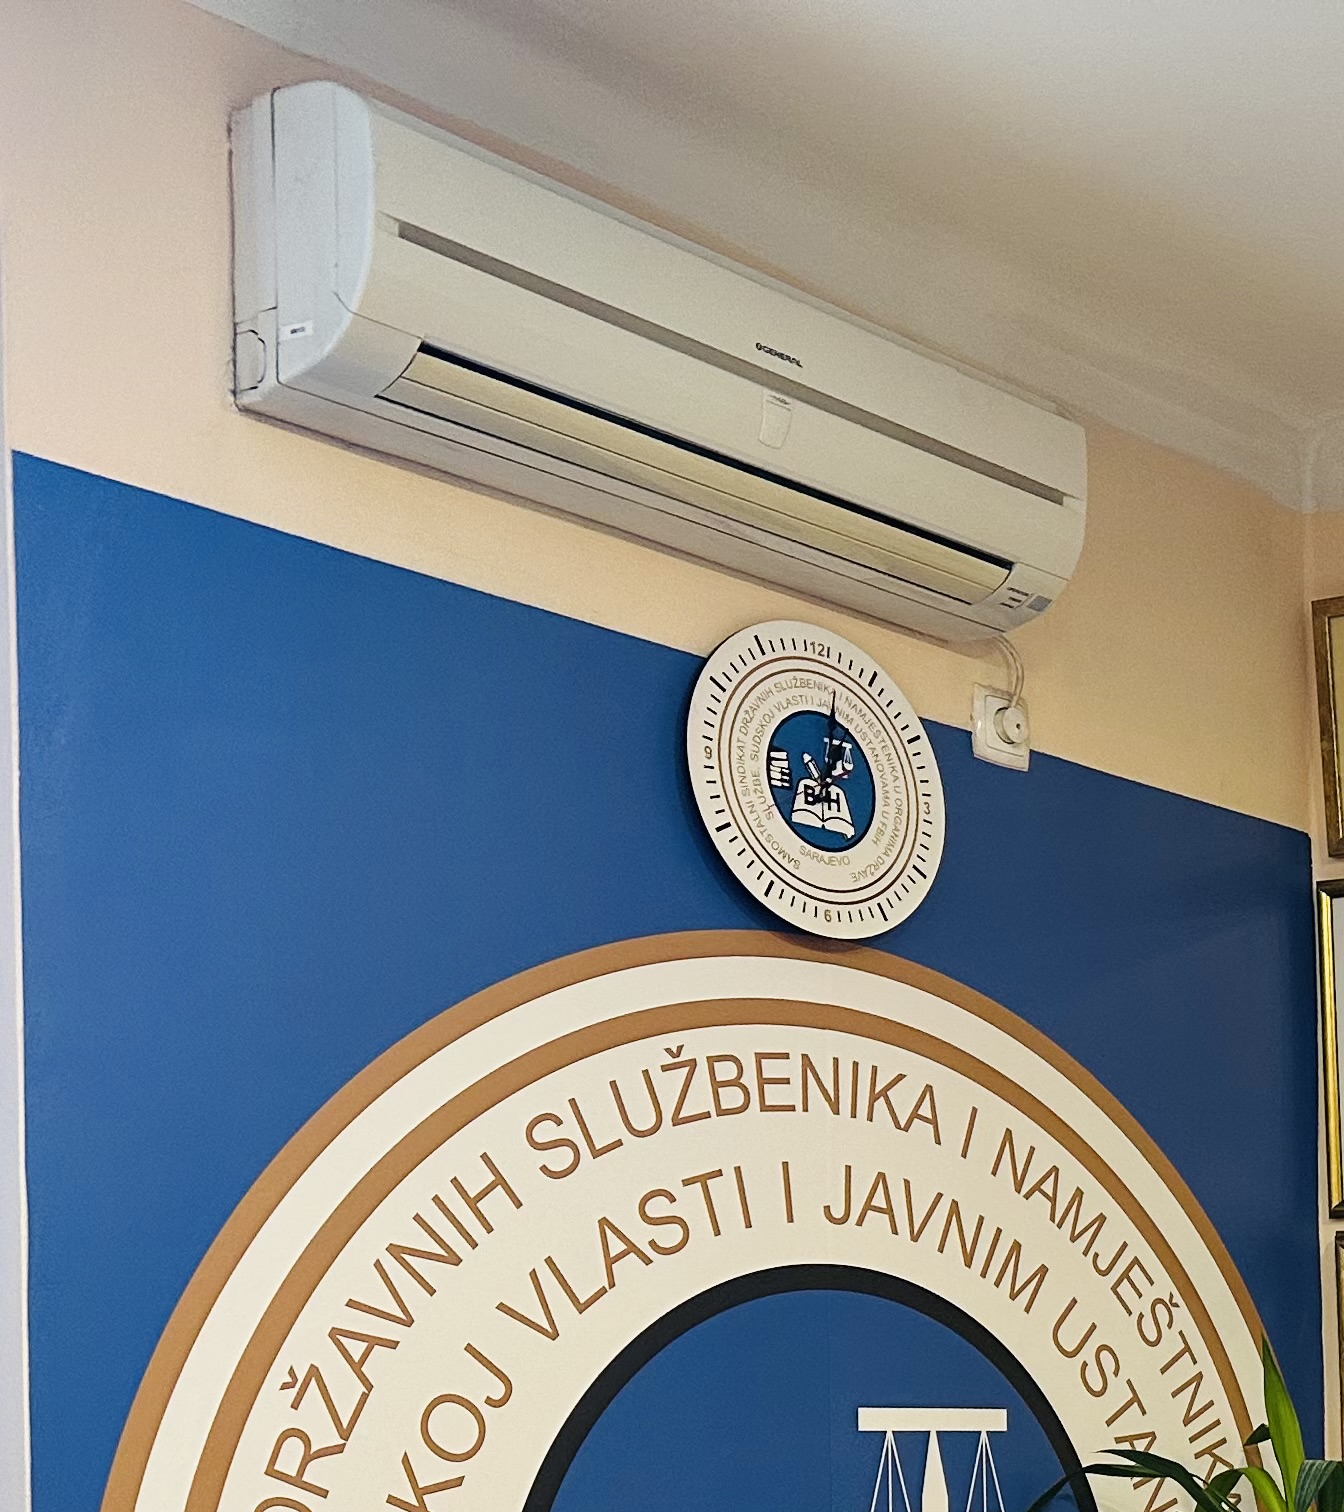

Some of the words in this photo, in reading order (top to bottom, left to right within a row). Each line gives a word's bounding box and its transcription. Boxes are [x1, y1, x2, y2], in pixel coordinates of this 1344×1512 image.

[809, 640, 825, 657] 12
[525, 1044, 942, 1180] SLUŽBENIKA
[960, 1105, 978, 1159] I
[495, 1164, 753, 1342] VLASTI
[781, 1161, 795, 1224] I
[822, 1164, 1050, 1315] JAVNIM
